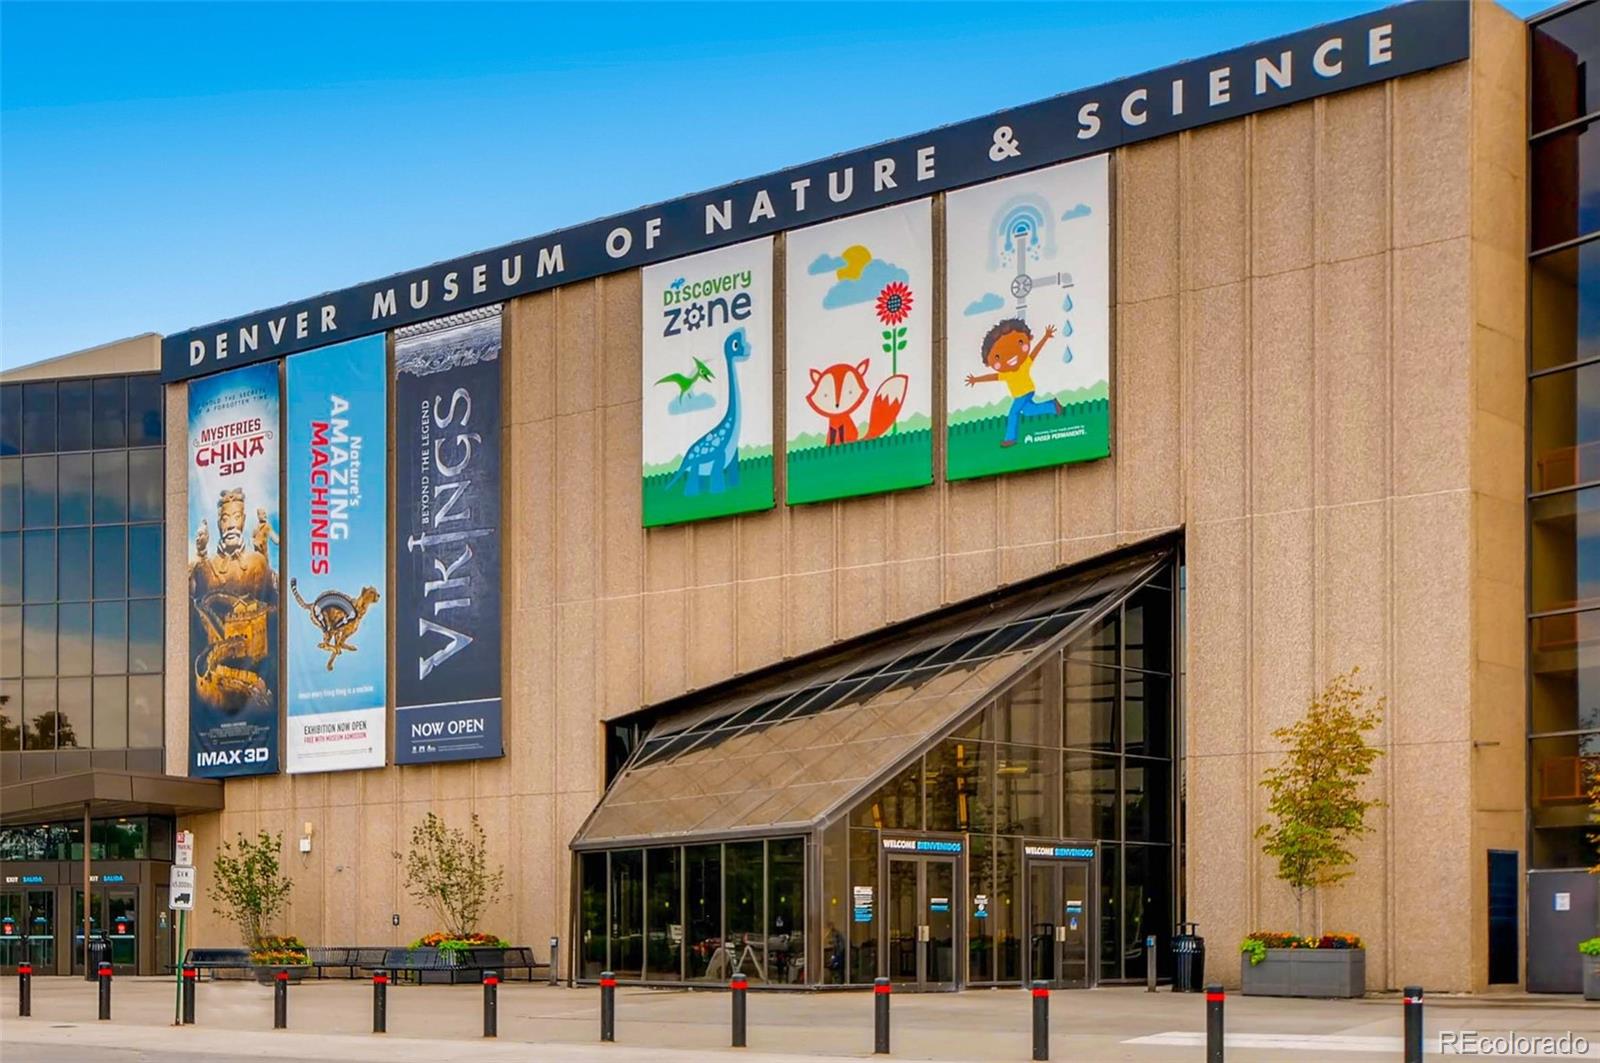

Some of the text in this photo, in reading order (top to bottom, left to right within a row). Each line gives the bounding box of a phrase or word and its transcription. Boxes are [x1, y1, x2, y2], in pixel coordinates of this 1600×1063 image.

[189, 23, 1393, 366] DENVER MUSEUM OF NATURE & SCIENCE
[201, 418, 261, 443] MYSTERIES
[195, 435, 265, 467] CHINA
[421, 400, 430, 524] BEYOND THE LEGEND
[219, 461, 245, 477] 3D
[330, 395, 349, 540] AMAZING
[350, 436, 362, 507] Nature's
[310, 421, 329, 575] MACHINES
[304, 720, 367, 735] EXHIBITION NOW OPEN
[411, 718, 484, 738] NOW OPEN
[197, 747, 269, 767] IMAX 3D
[882, 839, 961, 852] WELCOME BIENVENIDOS
[1025, 846, 1094, 857] WELCOME BIENVENIDOS
